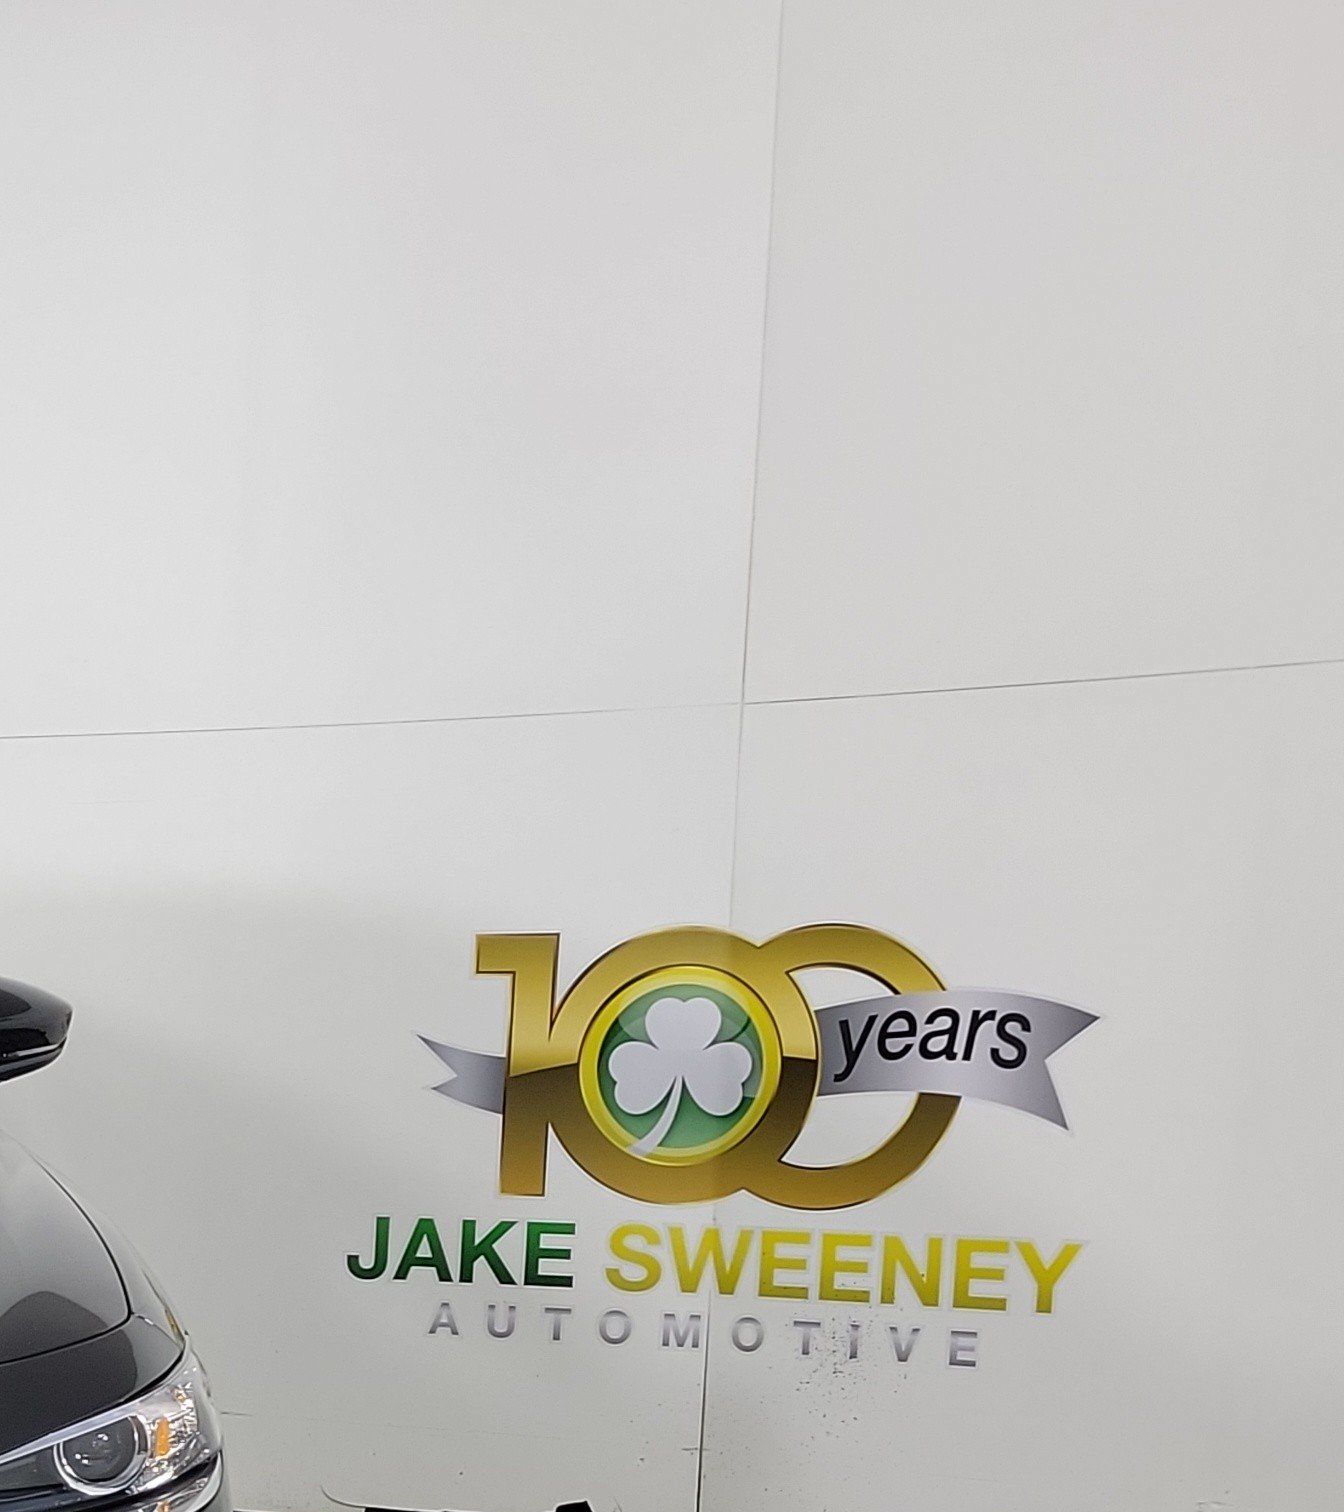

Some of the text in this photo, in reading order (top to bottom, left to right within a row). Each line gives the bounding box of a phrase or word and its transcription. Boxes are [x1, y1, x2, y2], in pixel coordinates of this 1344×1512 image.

[474, 922, 1032, 1211] 100 years
[345, 1215, 1085, 1315] JAKE SWEENEY
[427, 1301, 980, 1368] AUTOMOTIVE
